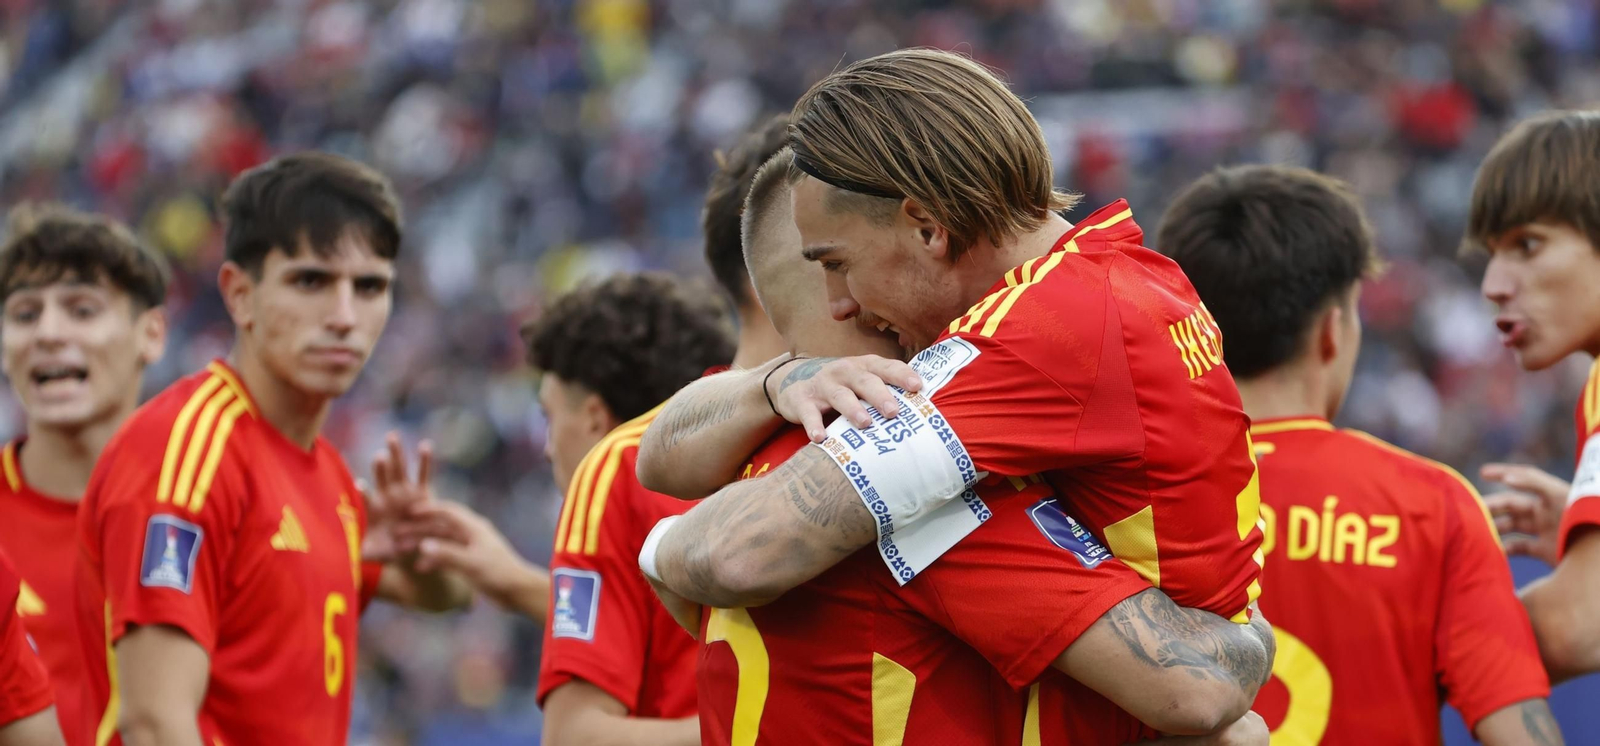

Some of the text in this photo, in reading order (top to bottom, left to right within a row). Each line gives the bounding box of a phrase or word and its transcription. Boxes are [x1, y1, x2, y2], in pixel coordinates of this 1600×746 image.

[844, 430, 862, 448] FIFA
[893, 395, 924, 434] OTBALL
[1287, 495, 1400, 568] DÍAZ
[323, 592, 346, 698] 6
